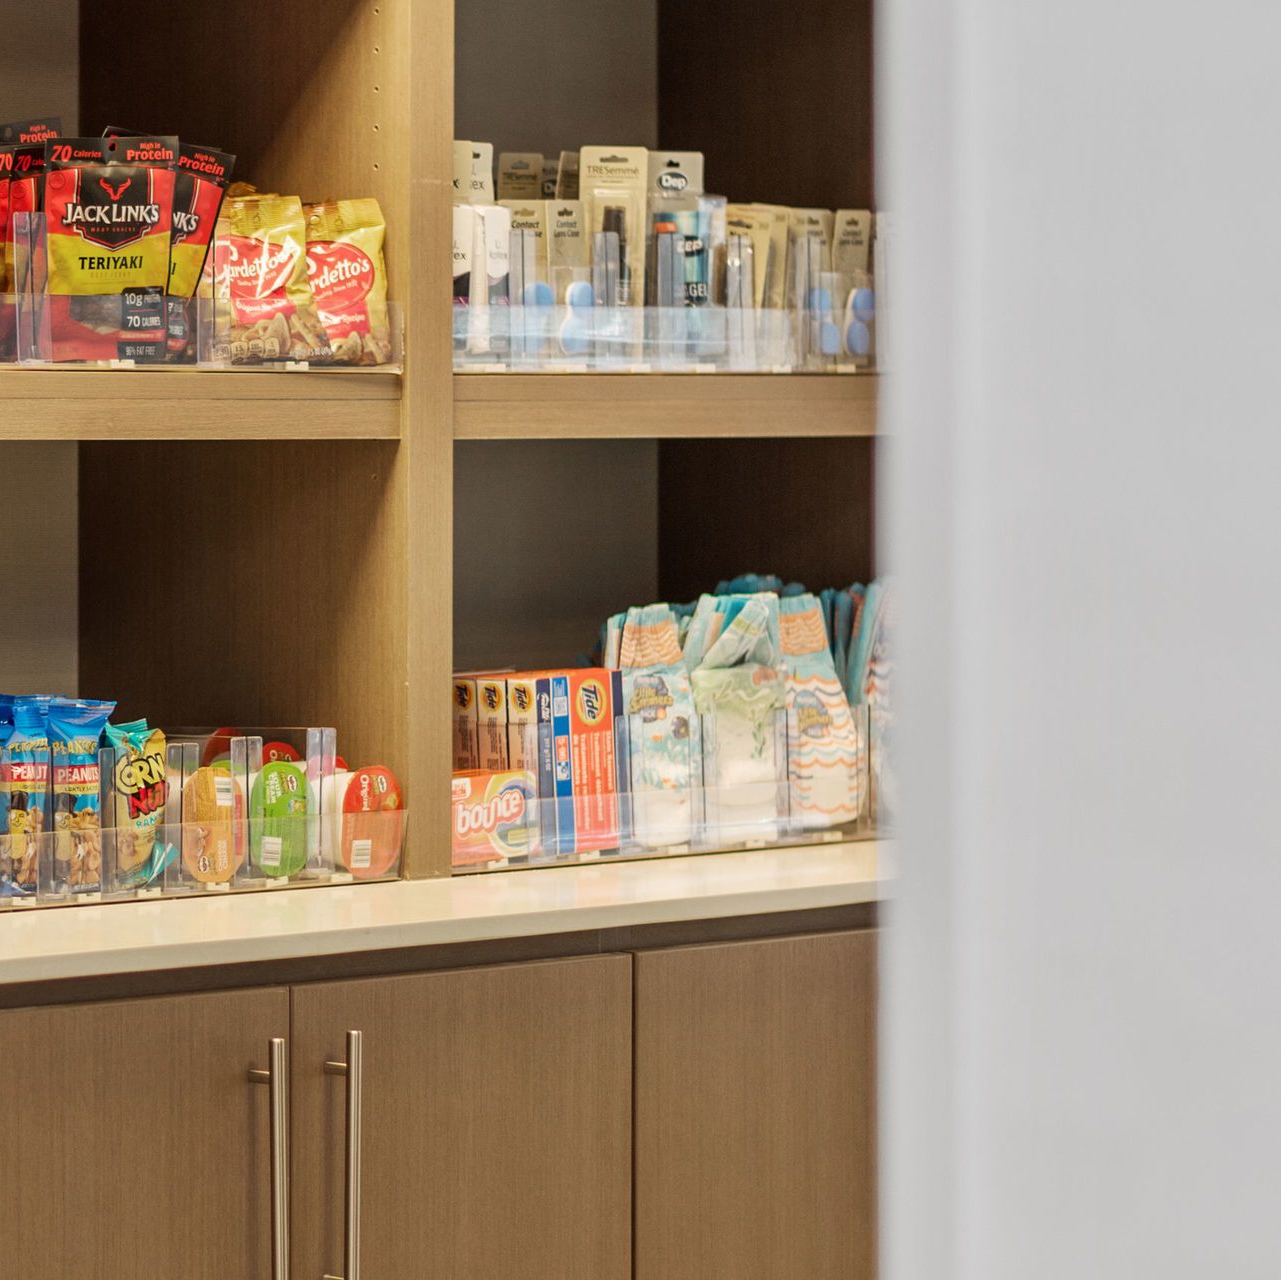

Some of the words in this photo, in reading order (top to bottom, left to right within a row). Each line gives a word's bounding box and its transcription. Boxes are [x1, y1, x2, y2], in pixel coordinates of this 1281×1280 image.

[20, 129, 58, 143] Protein
[50, 145, 73, 162] 70
[74, 149, 102, 158] Calories
[126, 147, 174, 161] Protein
[139, 142, 153, 150] High
[14, 155, 31, 172] 70
[178, 155, 225, 176] Protein
[661, 174, 687, 189] Dep
[62, 203, 111, 225] JACK
[511, 220, 540, 229] Contact
[78, 255, 144, 270] TERIYAKI
[124, 292, 143, 307] 10g
[126, 316, 140, 328] 70
[485, 685, 499, 709] Tide
[514, 686, 529, 710] Tide
[581, 685, 599, 720] Tide
[359, 774, 372, 811] Original
